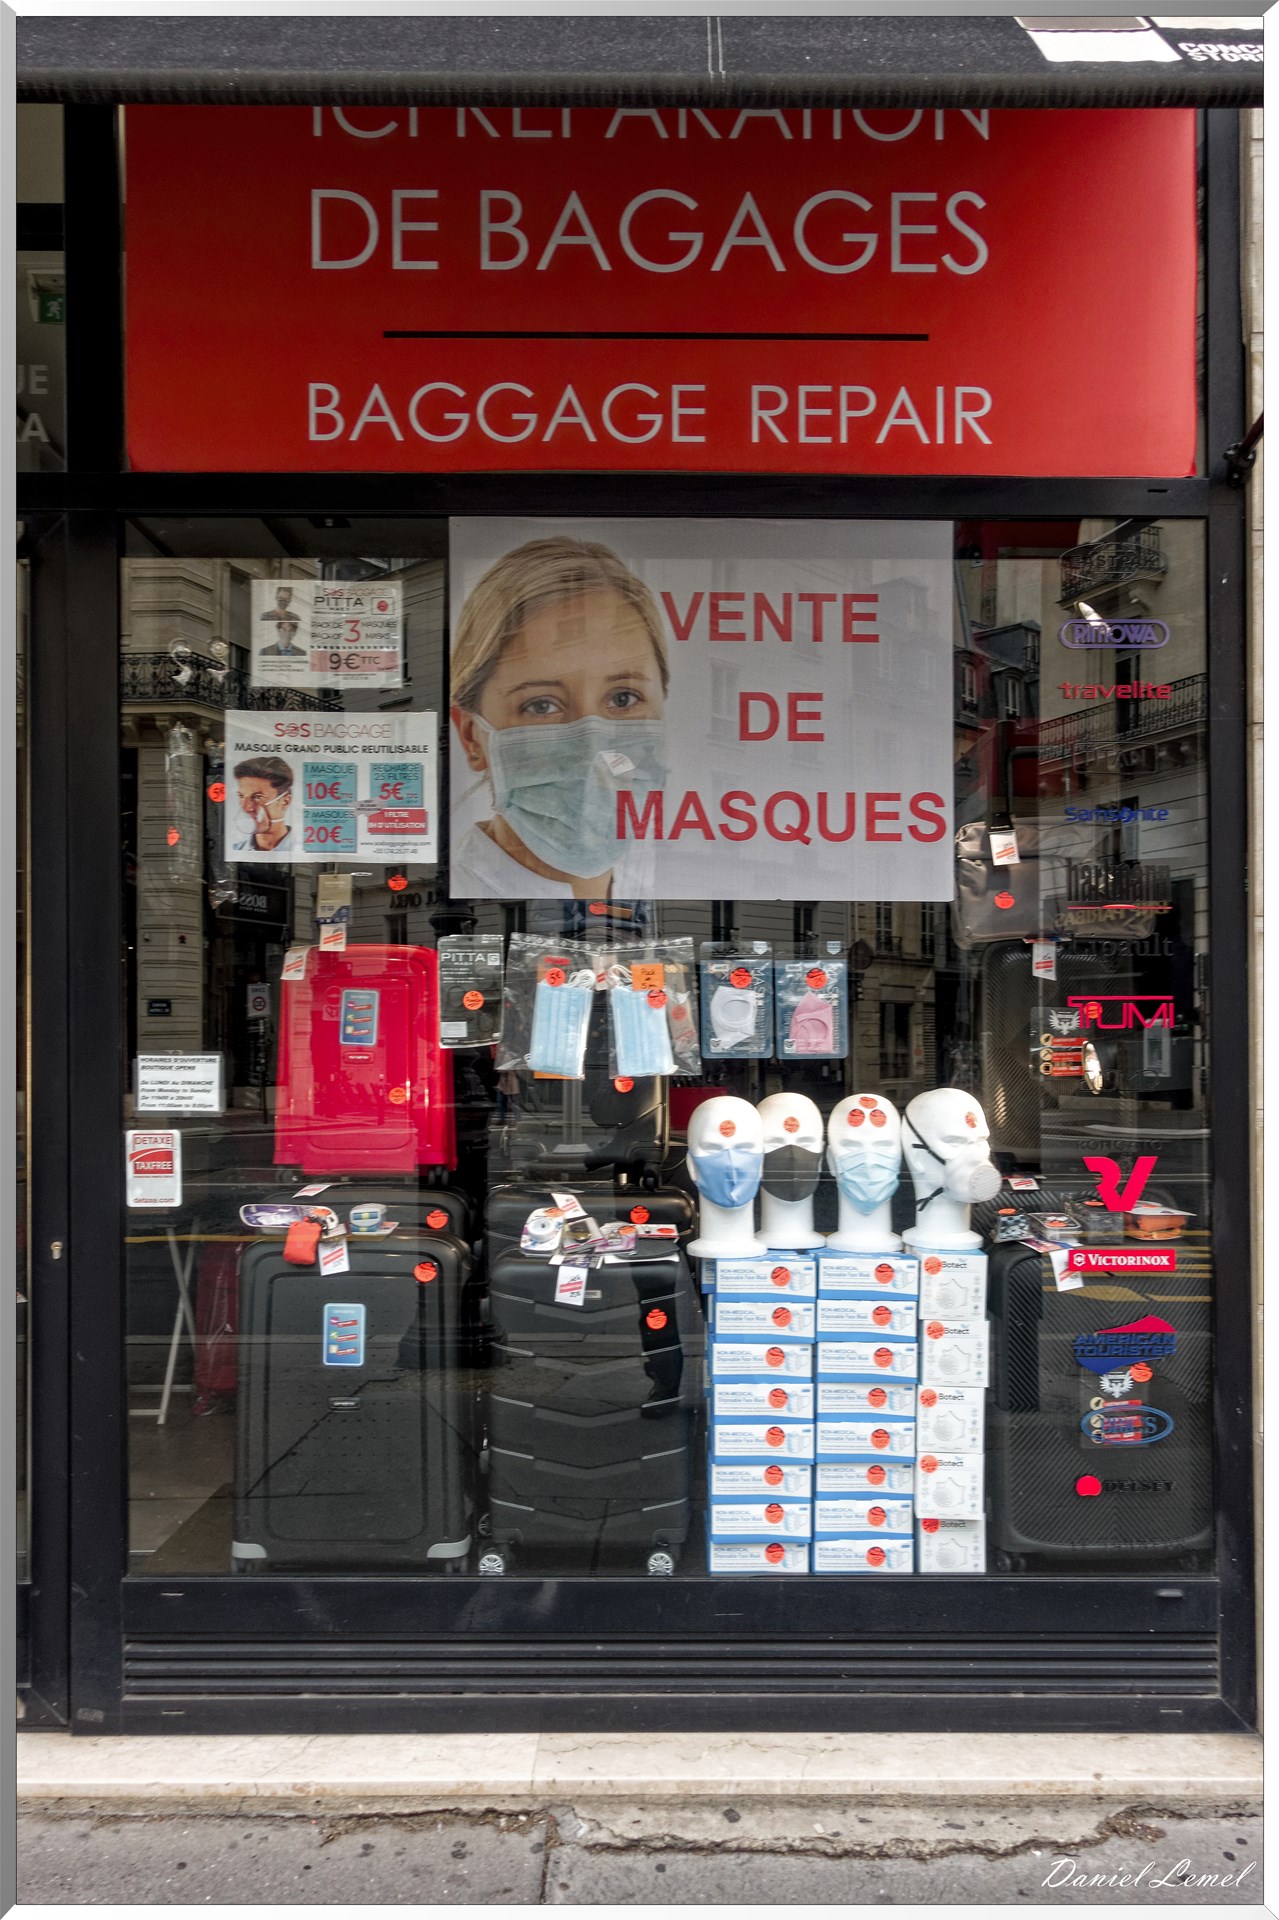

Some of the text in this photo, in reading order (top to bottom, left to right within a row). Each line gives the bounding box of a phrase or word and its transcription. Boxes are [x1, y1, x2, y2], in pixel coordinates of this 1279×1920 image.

[1178, 42, 1264, 54] CONC
[311, 189, 988, 274] DE BAGAGES
[308, 382, 993, 444] BAGGAGE REPAIR
[314, 596, 364, 607] PITTA
[661, 592, 880, 643] VENTE
[344, 619, 361, 643] 3
[329, 653, 381, 670] 9€ TTC
[1061, 680, 1173, 700] travelite
[738, 692, 825, 742] DE
[274, 722, 391, 739] SOS BAGGAGE
[234, 743, 429, 754] MASQUE GRAND PUBLIC REUTILISABLE
[311, 764, 355, 774] MASQUE
[373, 764, 421, 772] RECHARGE
[374, 772, 420, 781] 25 FILTRES
[306, 781, 342, 800] 10€
[378, 781, 405, 801] 5€
[311, 810, 356, 819] MASQUES
[616, 790, 947, 845] MASQUES
[1064, 806, 1169, 823] Samsonite
[303, 825, 343, 844] 20€
[440, 953, 486, 962] PITTA
[1067, 995, 1175, 1030] TUMI
[134, 1136, 172, 1145] DETAXE
[134, 1161, 173, 1170] TAXFREE
[1073, 1334, 1178, 1345] AMERICAN
[1073, 1345, 1178, 1356] TOURISTER
[1104, 1480, 1175, 1492] DELSEY
